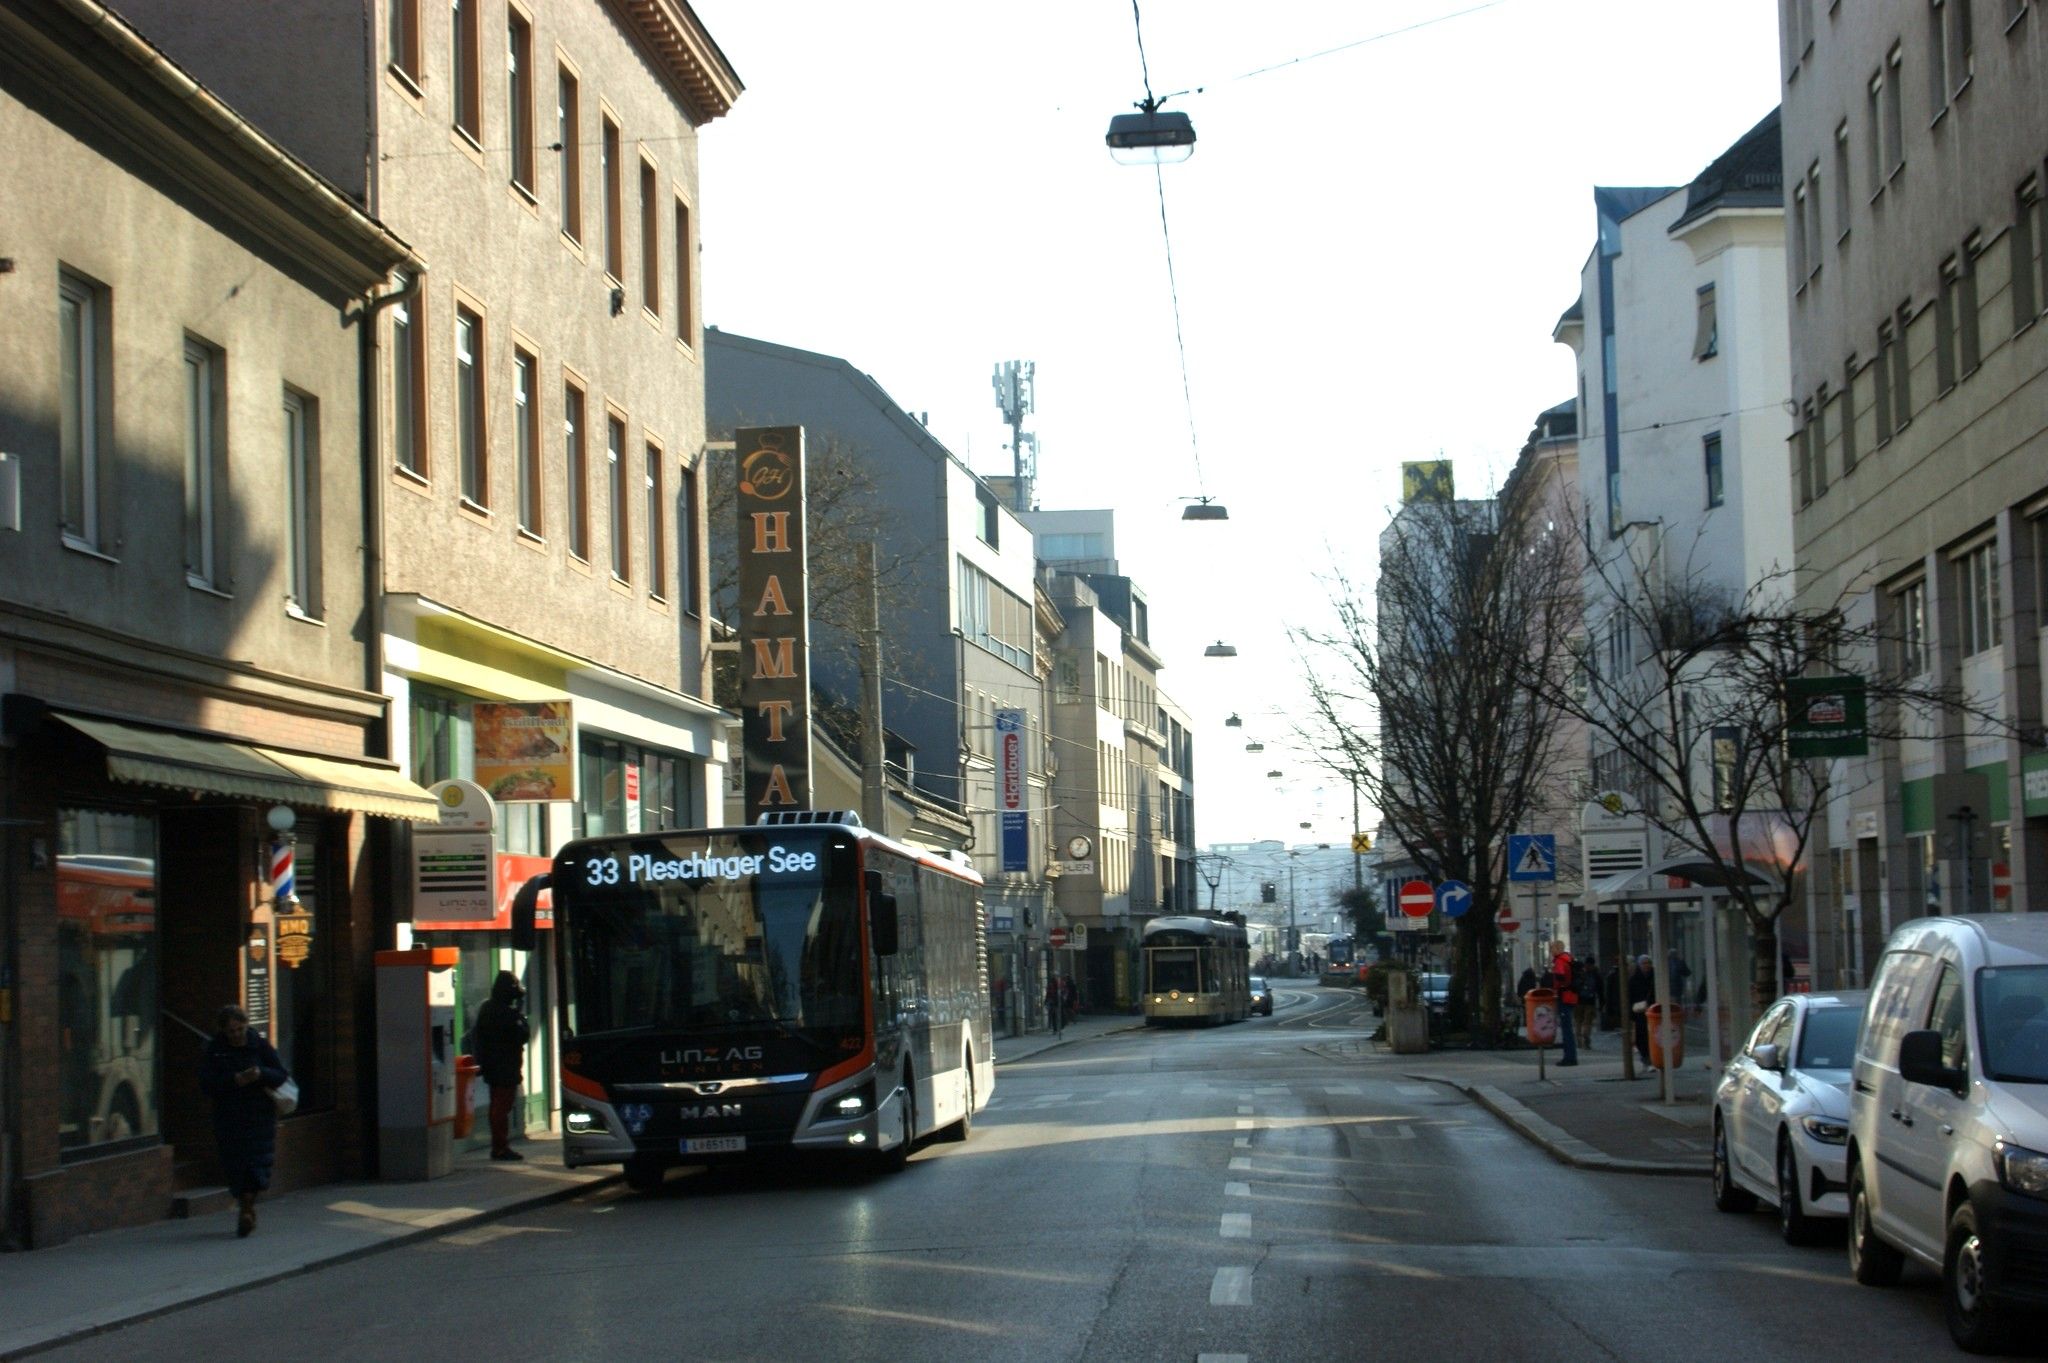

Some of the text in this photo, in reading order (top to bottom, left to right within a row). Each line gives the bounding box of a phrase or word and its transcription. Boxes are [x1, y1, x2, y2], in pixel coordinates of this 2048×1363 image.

[750, 511, 798, 806] HAMTA
[1006, 738, 1020, 803] Hartlauer
[585, 857, 620, 886] 33
[628, 851, 765, 882] Pleschinger
[768, 846, 817, 873] See
[725, 1046, 763, 1061] AG
[680, 1103, 742, 1120] MAN
